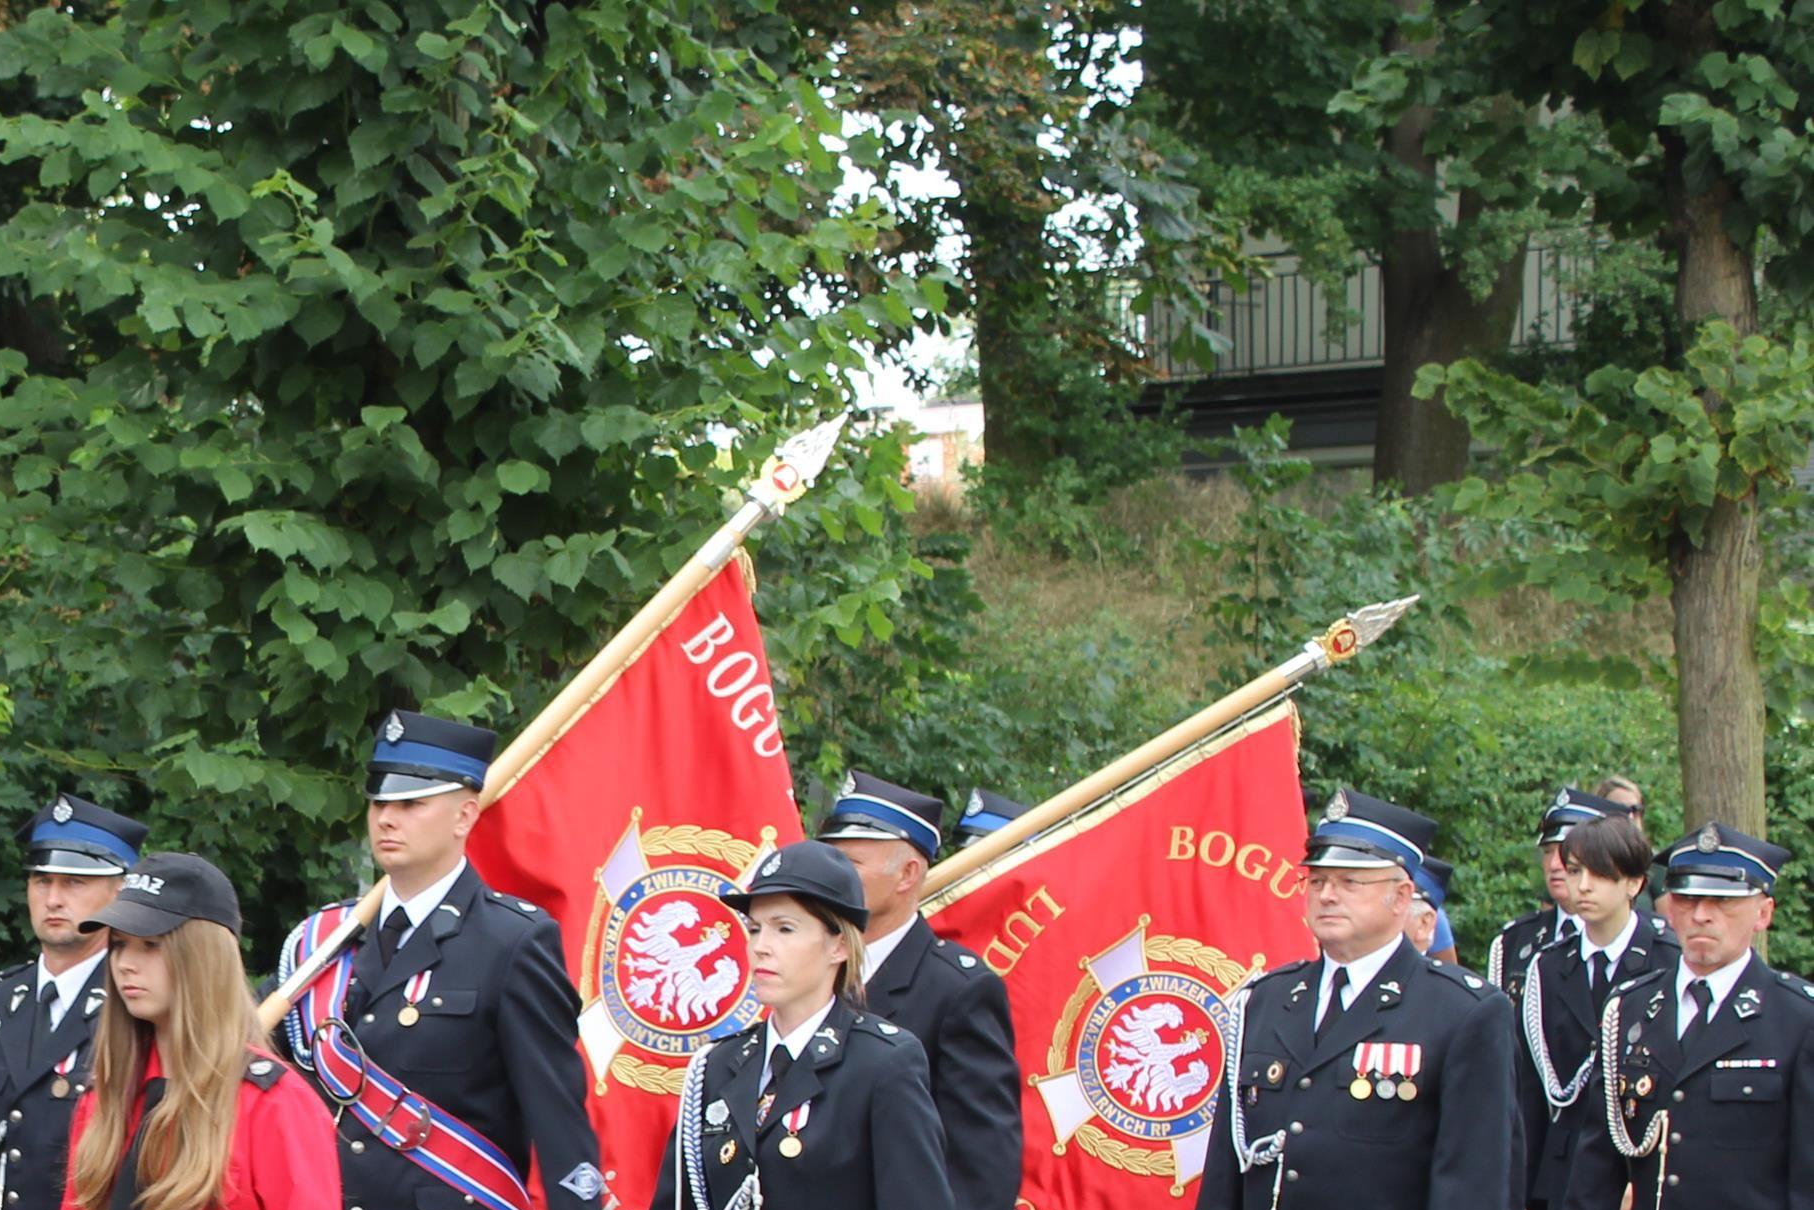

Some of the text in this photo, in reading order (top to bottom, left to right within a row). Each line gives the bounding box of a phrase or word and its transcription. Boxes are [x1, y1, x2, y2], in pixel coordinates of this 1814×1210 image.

[679, 611, 784, 758] BOGU
[1165, 825, 1305, 899] BOGU
[1150, 1121, 1173, 1138] RP
